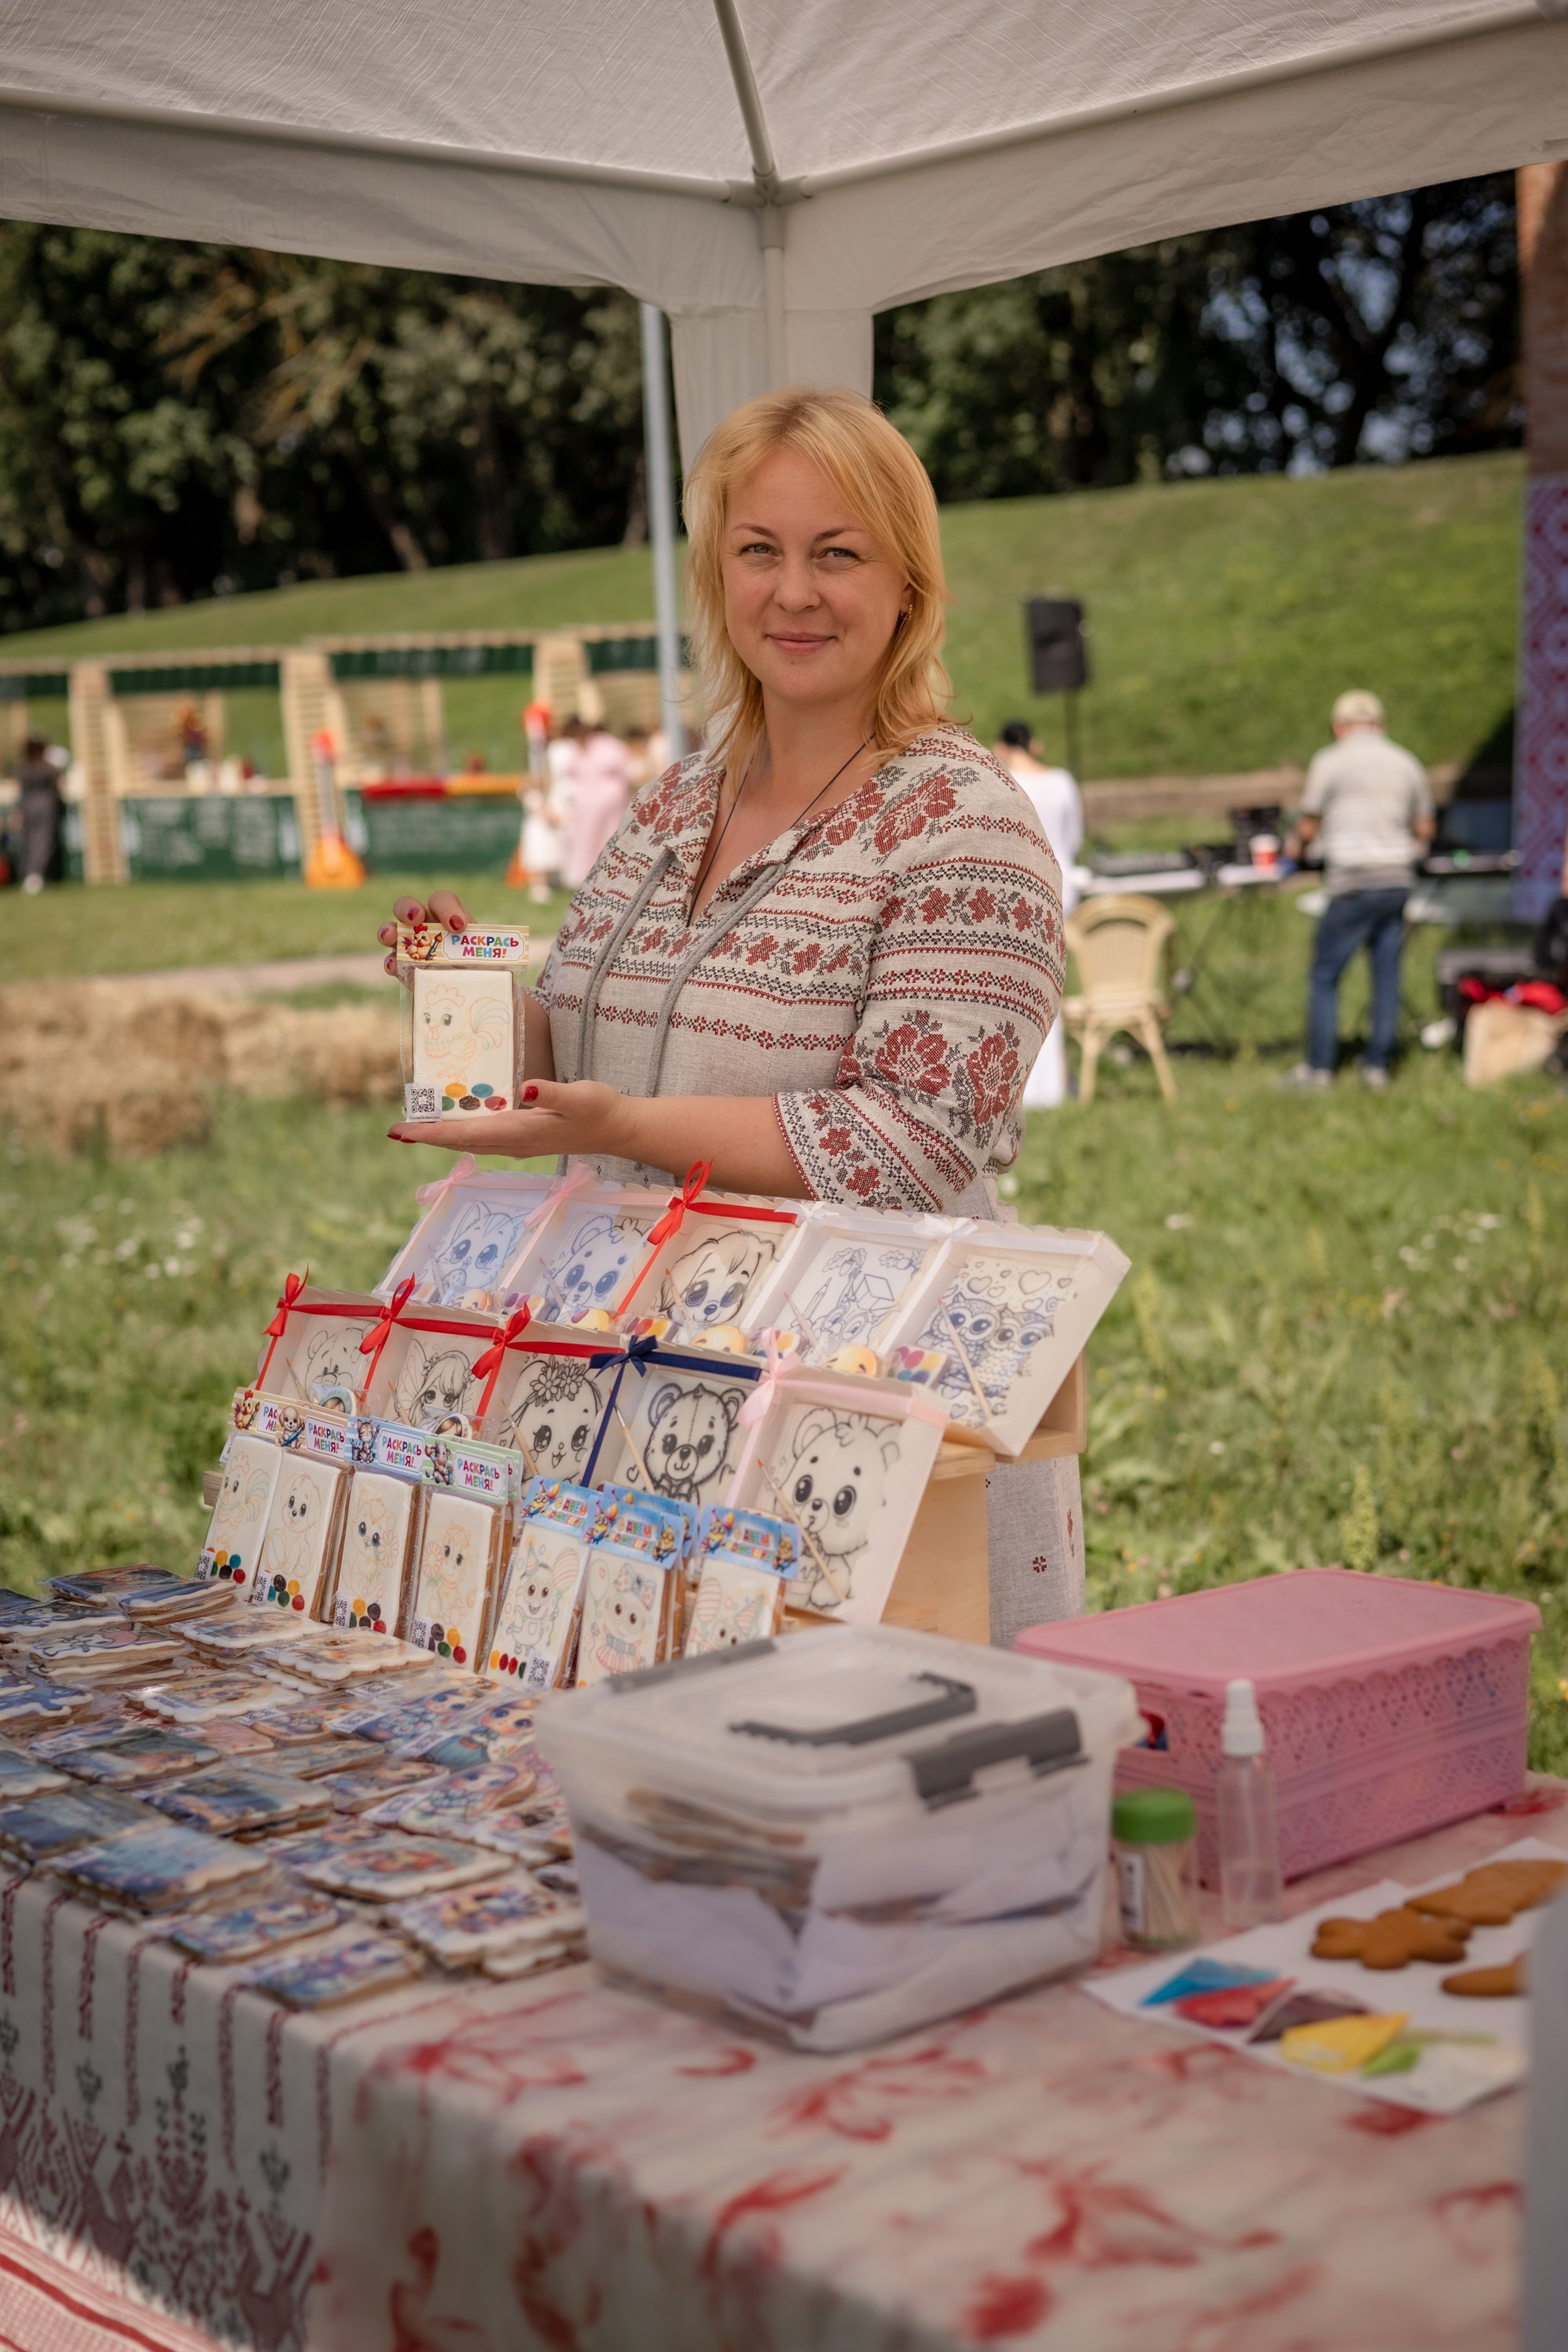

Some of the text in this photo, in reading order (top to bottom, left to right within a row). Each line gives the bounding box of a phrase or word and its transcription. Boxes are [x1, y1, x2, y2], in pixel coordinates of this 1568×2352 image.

[452, 935, 519, 947] РАСКРАСЬ
[463, 946, 507, 958] МЕНЯ!
[308, 1422, 345, 1443] РАСКРАСЬ
[314, 1438, 339, 1454] МЕНЯ!
[382, 1436, 422, 1456] РАСКРАСЬ
[387, 1451, 414, 1468] МЕНЯ!
[457, 1457, 500, 1479] РАСКРАСЬ
[465, 1474, 493, 1490] МЕНЯ!
